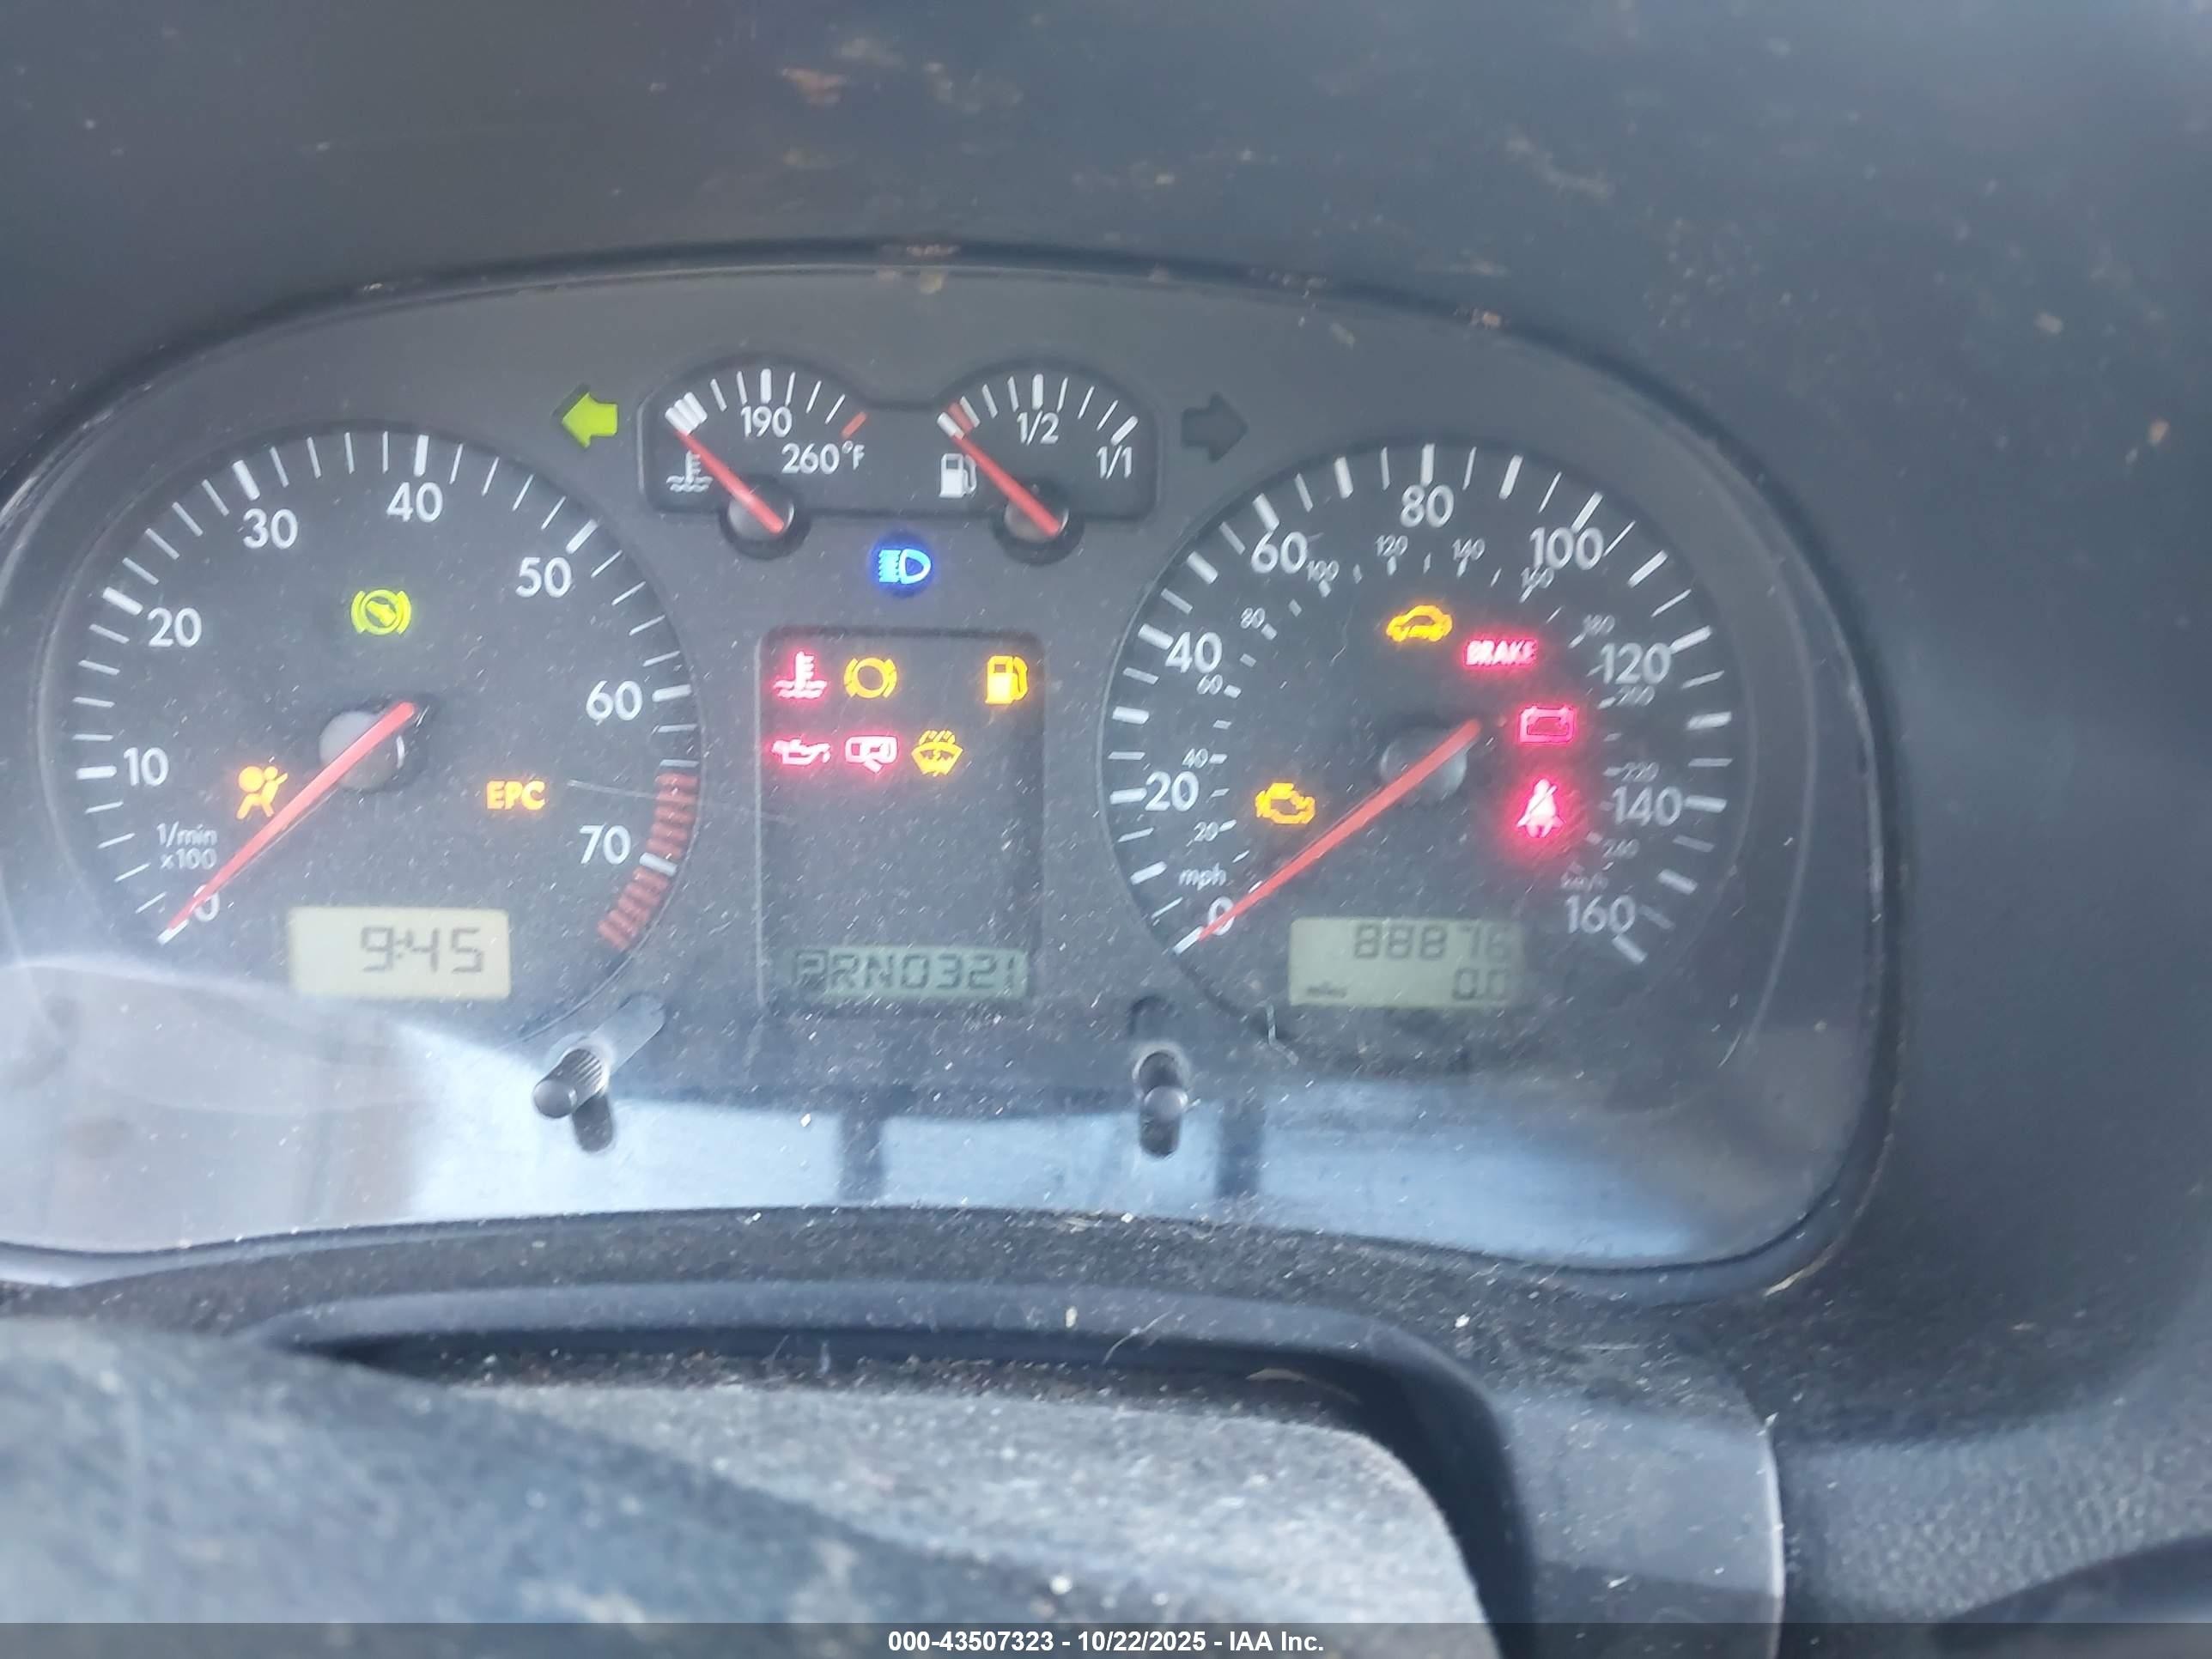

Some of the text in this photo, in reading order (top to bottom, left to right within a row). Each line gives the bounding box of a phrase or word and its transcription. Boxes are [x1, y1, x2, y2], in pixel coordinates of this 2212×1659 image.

[741, 405, 792, 438] 190
[1017, 410, 1059, 446] 1/2
[1096, 445, 1132, 479] 1/1
[386, 482, 443, 522] 40
[1400, 484, 1455, 528] 80
[243, 508, 298, 550] 30
[1375, 535, 1408, 557] 120
[1451, 538, 1486, 560] 140
[1529, 526, 1604, 570] 100
[1251, 531, 1308, 574] 60
[1307, 560, 1340, 581] 100
[515, 556, 572, 598] 50
[147, 606, 202, 647] 20
[1240, 607, 1266, 629] 80
[1165, 631, 1223, 673] 40
[1465, 640, 1537, 665] BRAKE
[1601, 642, 1672, 684] 120
[586, 680, 642, 721] 60
[1196, 674, 1224, 695] 60
[123, 746, 169, 787] 10
[1182, 748, 1209, 769] 40
[485, 780, 546, 811] EPC
[1145, 771, 1200, 811] 20
[1612, 786, 1683, 827] 140
[156, 822, 218, 847] 1/min
[579, 824, 631, 866] 70
[1194, 821, 1219, 842] 20
[1178, 864, 1227, 891] mph
[1565, 895, 1636, 935] 160
[361, 927, 483, 973] 9:45
